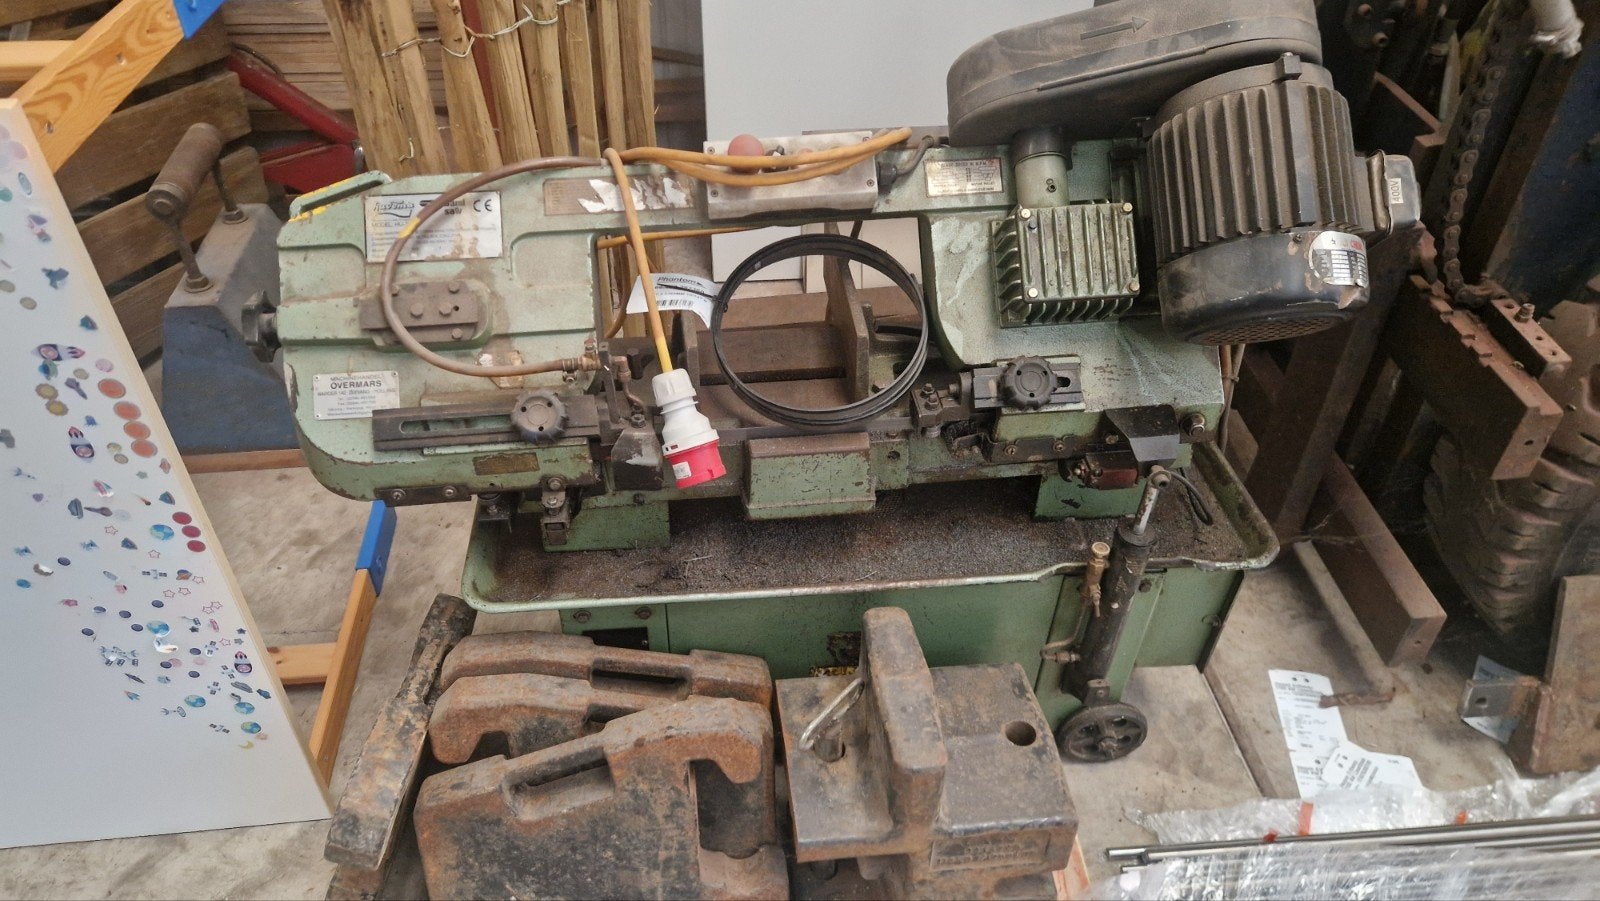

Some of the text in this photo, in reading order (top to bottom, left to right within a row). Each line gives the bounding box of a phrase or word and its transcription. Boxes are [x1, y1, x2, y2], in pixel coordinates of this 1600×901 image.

[1390, 180, 1400, 202] 400V
[657, 276, 696, 285] Phantom
[330, 380, 382, 390] OVERMARS
